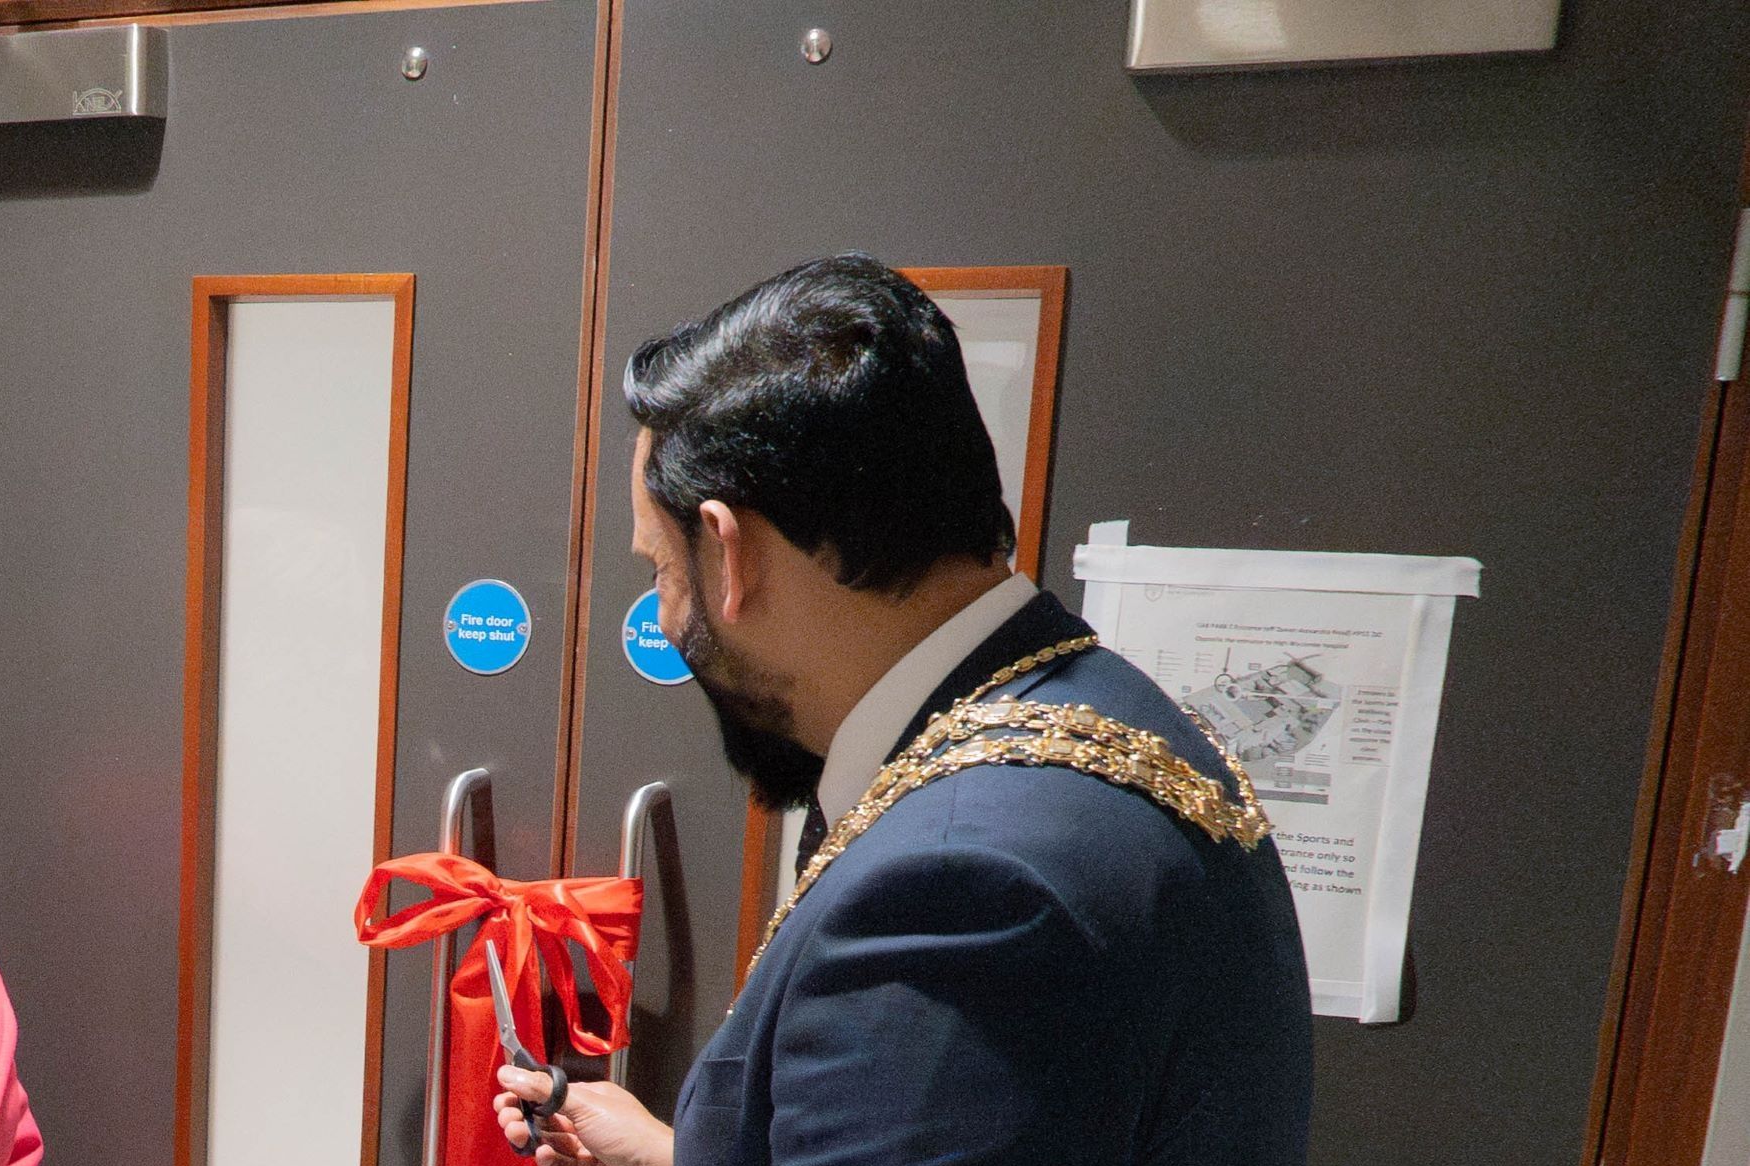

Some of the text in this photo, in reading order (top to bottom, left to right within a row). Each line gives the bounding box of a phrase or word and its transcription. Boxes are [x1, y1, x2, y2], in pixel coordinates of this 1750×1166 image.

[461, 613, 514, 627] Fire door
[458, 627, 516, 643] keep shut
[638, 635, 669, 651] keep
[1276, 832, 1354, 847] the Sports and
[1316, 852, 1341, 863] only
[1342, 855, 1356, 863] so
[1300, 864, 1334, 876] follow
[1336, 869, 1355, 879] the
[1326, 883, 1362, 895] shown
